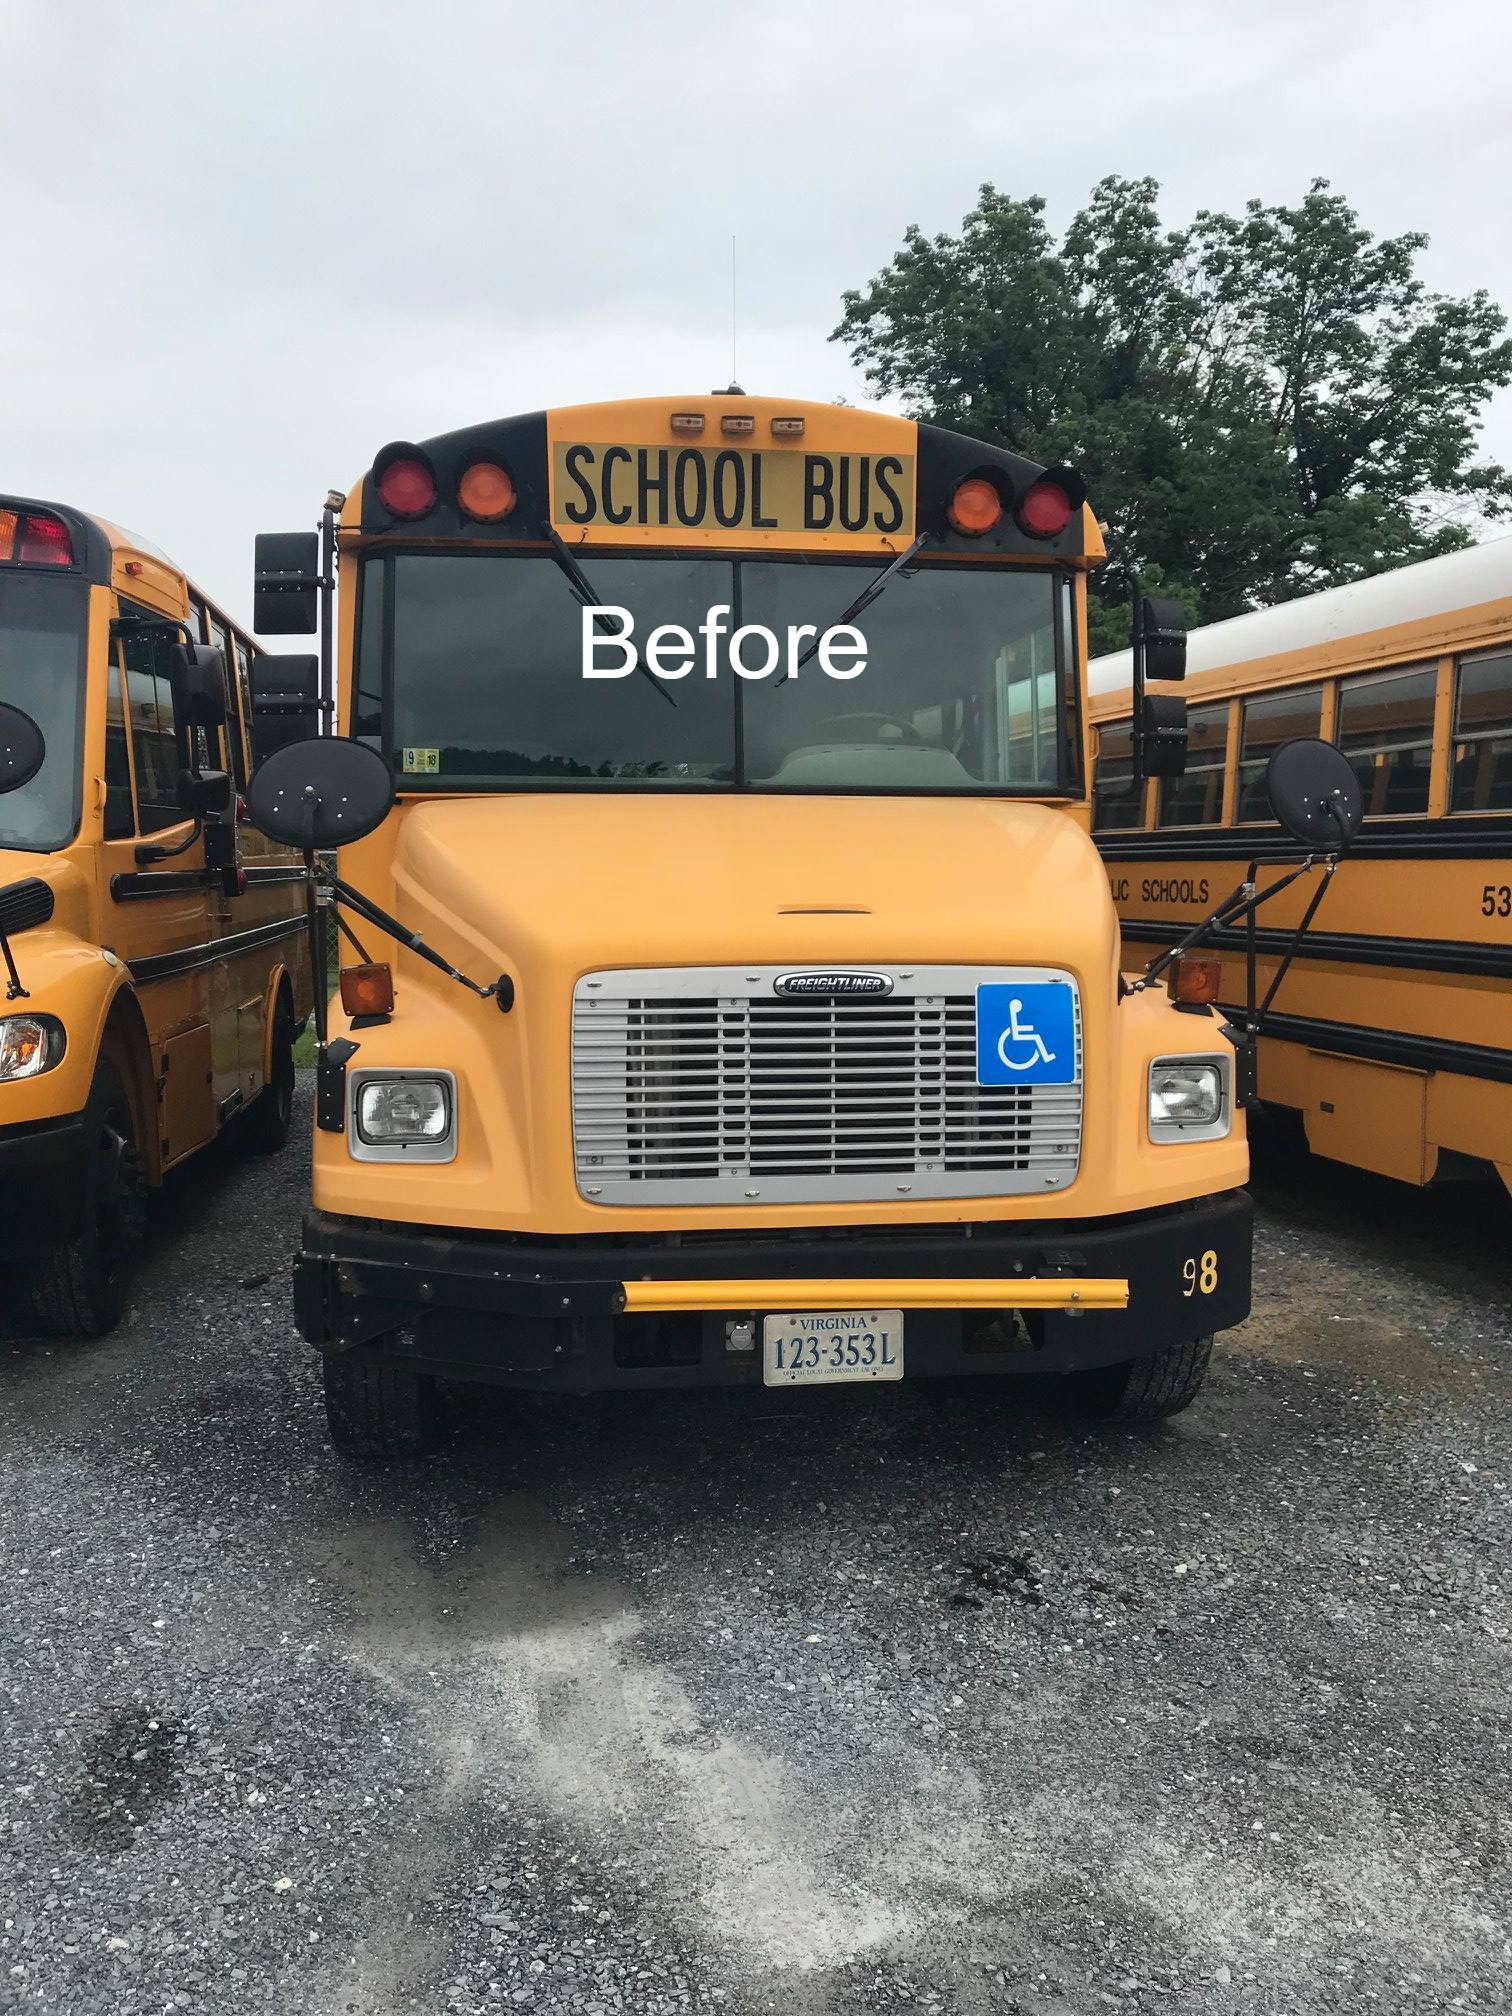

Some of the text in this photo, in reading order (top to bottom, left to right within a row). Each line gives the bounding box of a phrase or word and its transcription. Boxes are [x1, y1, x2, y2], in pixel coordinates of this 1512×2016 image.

[564, 445, 904, 533] SCHOOL BUS
[408, 751, 415, 765] 9
[427, 754, 436, 766] 18
[1141, 879, 1209, 903] SCHOOLS
[1481, 885, 1512, 917] 53
[788, 977, 882, 990] FREIGHTLINER
[1182, 1249, 1218, 1297] 98
[799, 1317, 868, 1330] VIRGINIA
[774, 1331, 897, 1369] 123-353L
